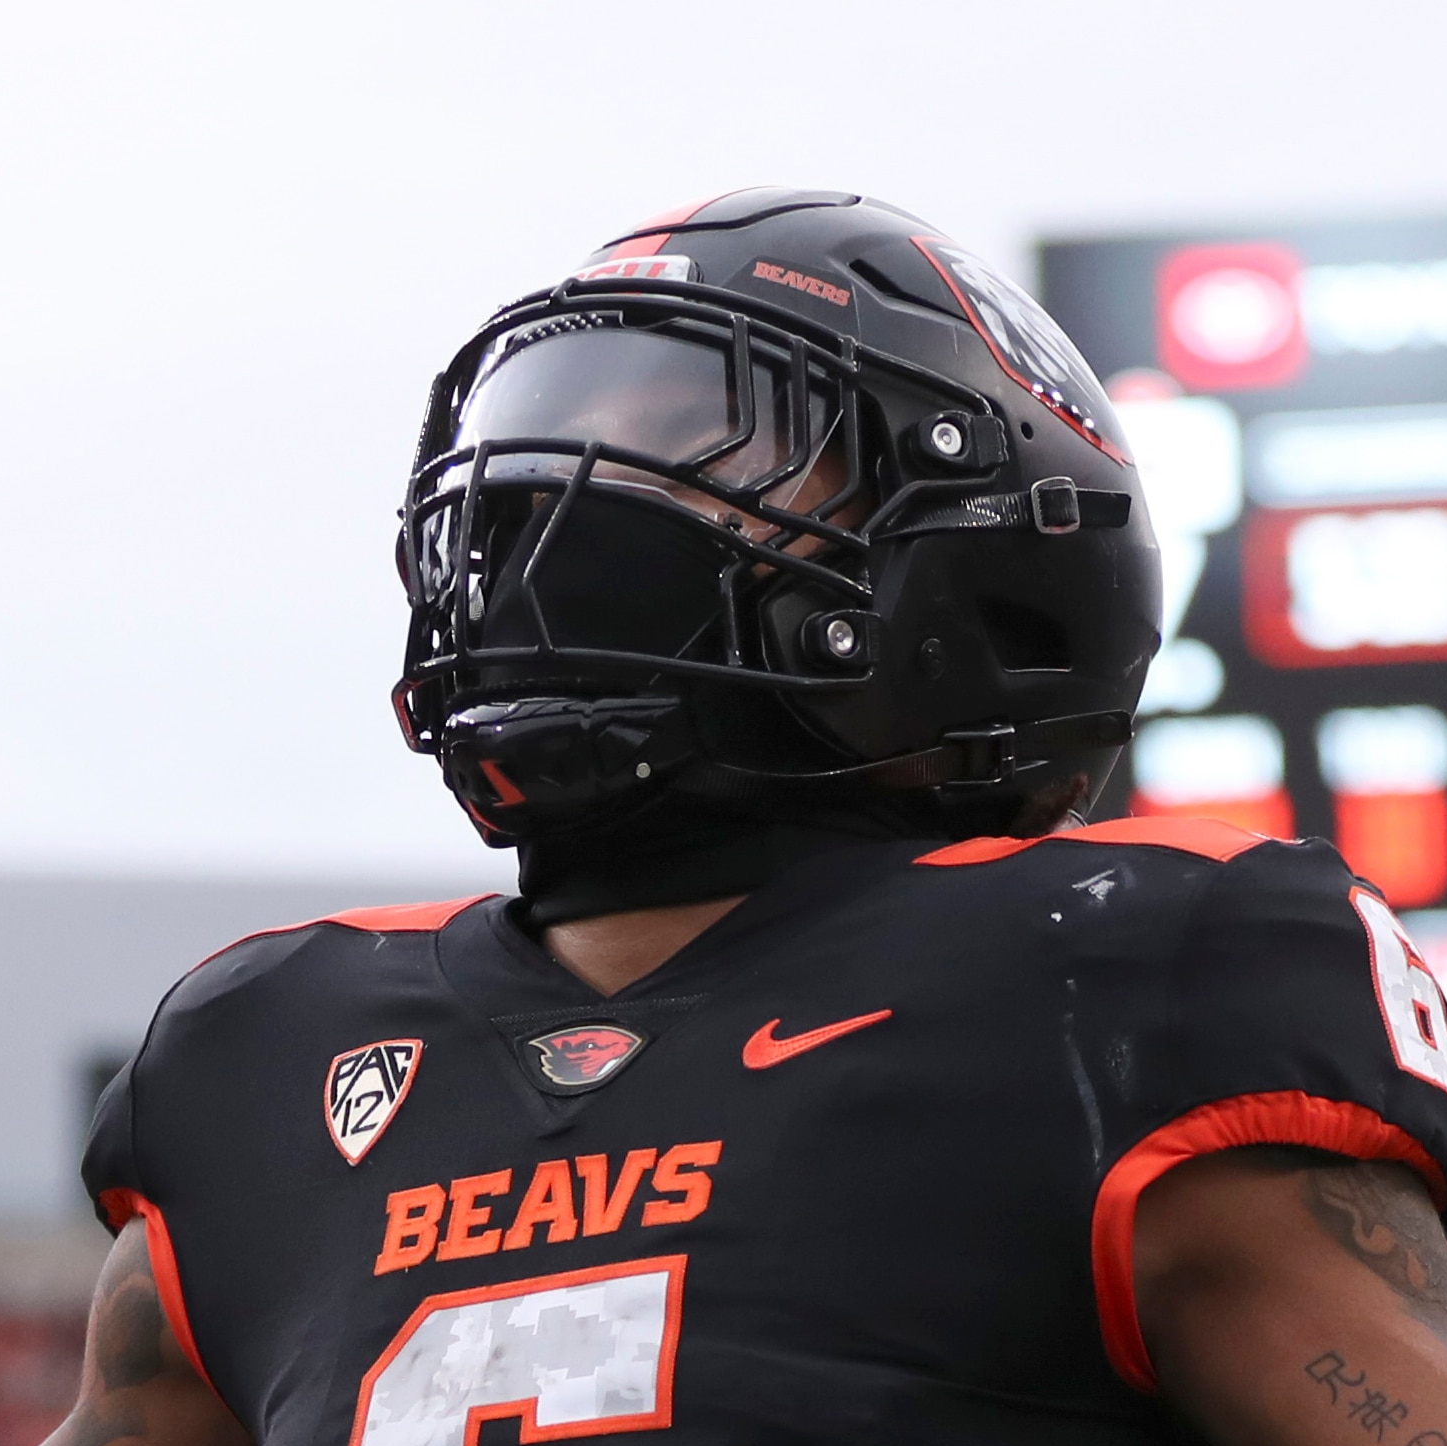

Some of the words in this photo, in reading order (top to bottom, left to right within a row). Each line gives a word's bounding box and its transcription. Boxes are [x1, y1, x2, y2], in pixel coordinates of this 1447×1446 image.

[753, 261, 851, 307] BEAVERS
[331, 1046, 414, 1120] PAC
[341, 1090, 384, 1138] 12
[373, 1140, 723, 1276] BEAVS
